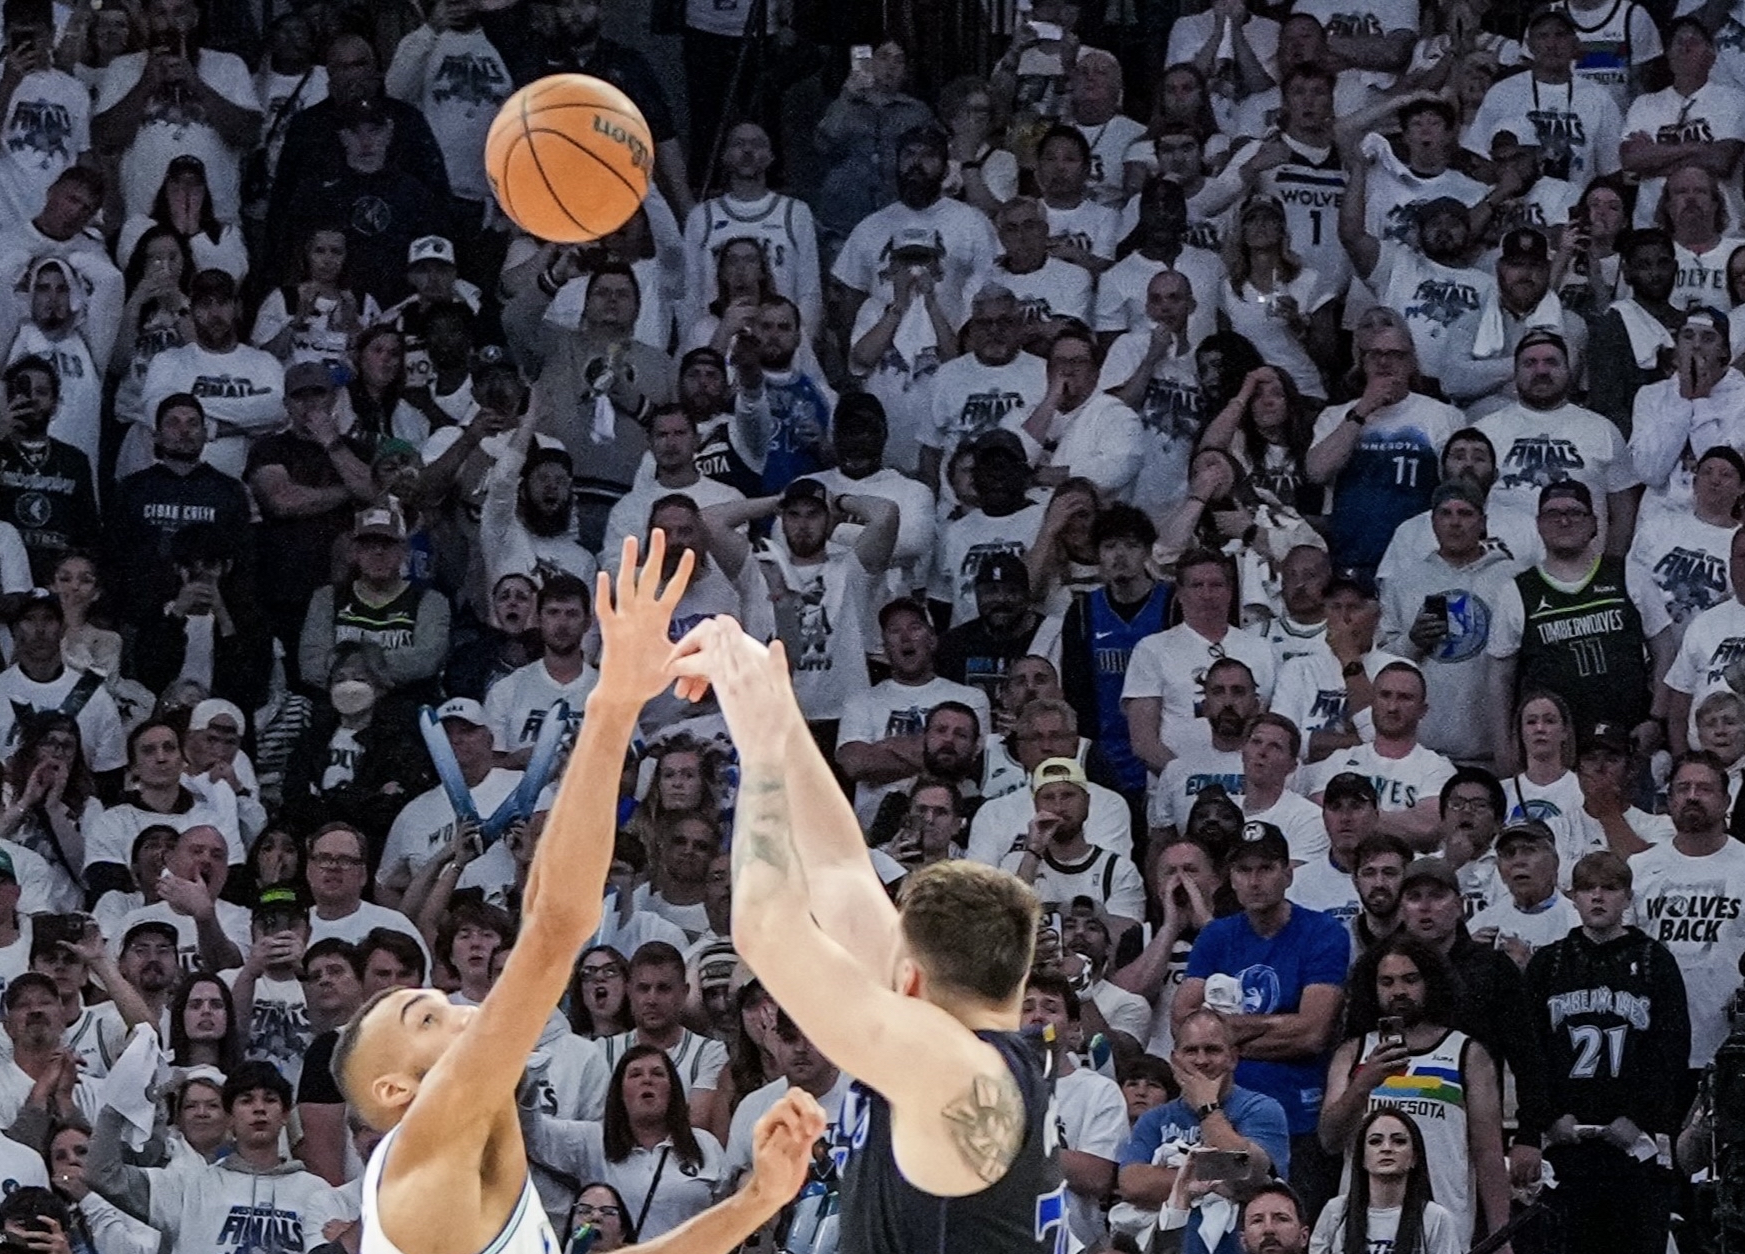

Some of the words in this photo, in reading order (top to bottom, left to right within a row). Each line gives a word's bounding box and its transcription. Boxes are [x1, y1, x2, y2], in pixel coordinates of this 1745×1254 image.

[1310, 210, 1322, 246] 1
[1392, 456, 1419, 488] 11
[1538, 610, 1624, 645] TIMBERWOLVES
[1569, 636, 1607, 676] 11
[1658, 920, 1724, 943] BACK
[1568, 1023, 1629, 1079] 21
[216, 1215, 304, 1252] FINALS
